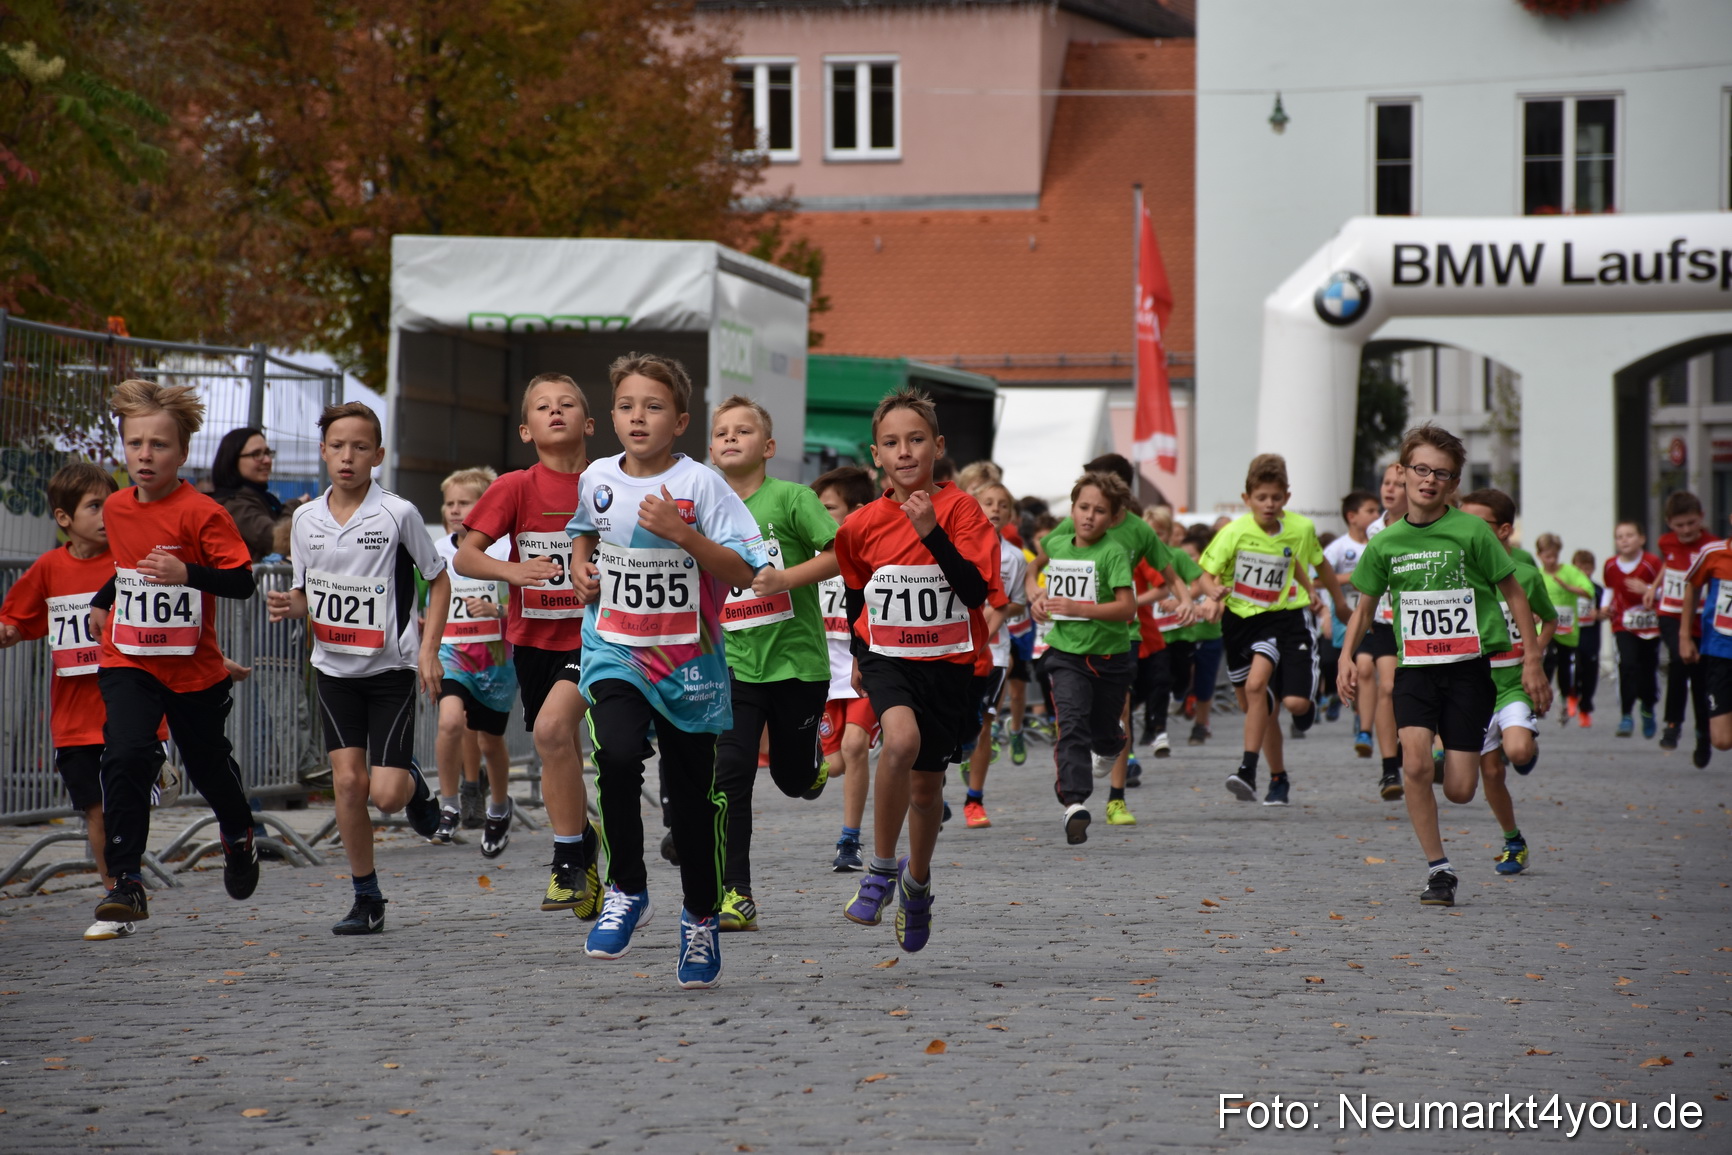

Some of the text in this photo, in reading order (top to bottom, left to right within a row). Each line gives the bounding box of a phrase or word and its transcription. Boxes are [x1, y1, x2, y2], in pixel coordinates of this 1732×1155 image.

[1392, 243, 1545, 286] BMW
[595, 517, 611, 525] ARTL
[519, 540, 548, 550] PARTL
[602, 553, 679, 568] PARTL Neumarkt
[1391, 551, 1441, 565] Neumarkter
[1392, 560, 1431, 574] Stadtlauf
[1242, 564, 1284, 589] 7144
[307, 577, 371, 593] PARTL Neumarkt
[608, 569, 689, 609] 7555
[121, 590, 192, 623] 7164
[313, 590, 375, 626] 7021
[875, 586, 956, 622] 7107
[1402, 597, 1460, 606] PARTL Neumarkt
[725, 601, 774, 619] Benjamin
[1407, 608, 1470, 636] 7052
[138, 631, 167, 644] Luca
[329, 629, 356, 643] Lauri
[454, 625, 479, 635] Jonas
[899, 631, 939, 644] Jamie
[1426, 642, 1452, 654] Felix
[681, 665, 703, 682] 16.
